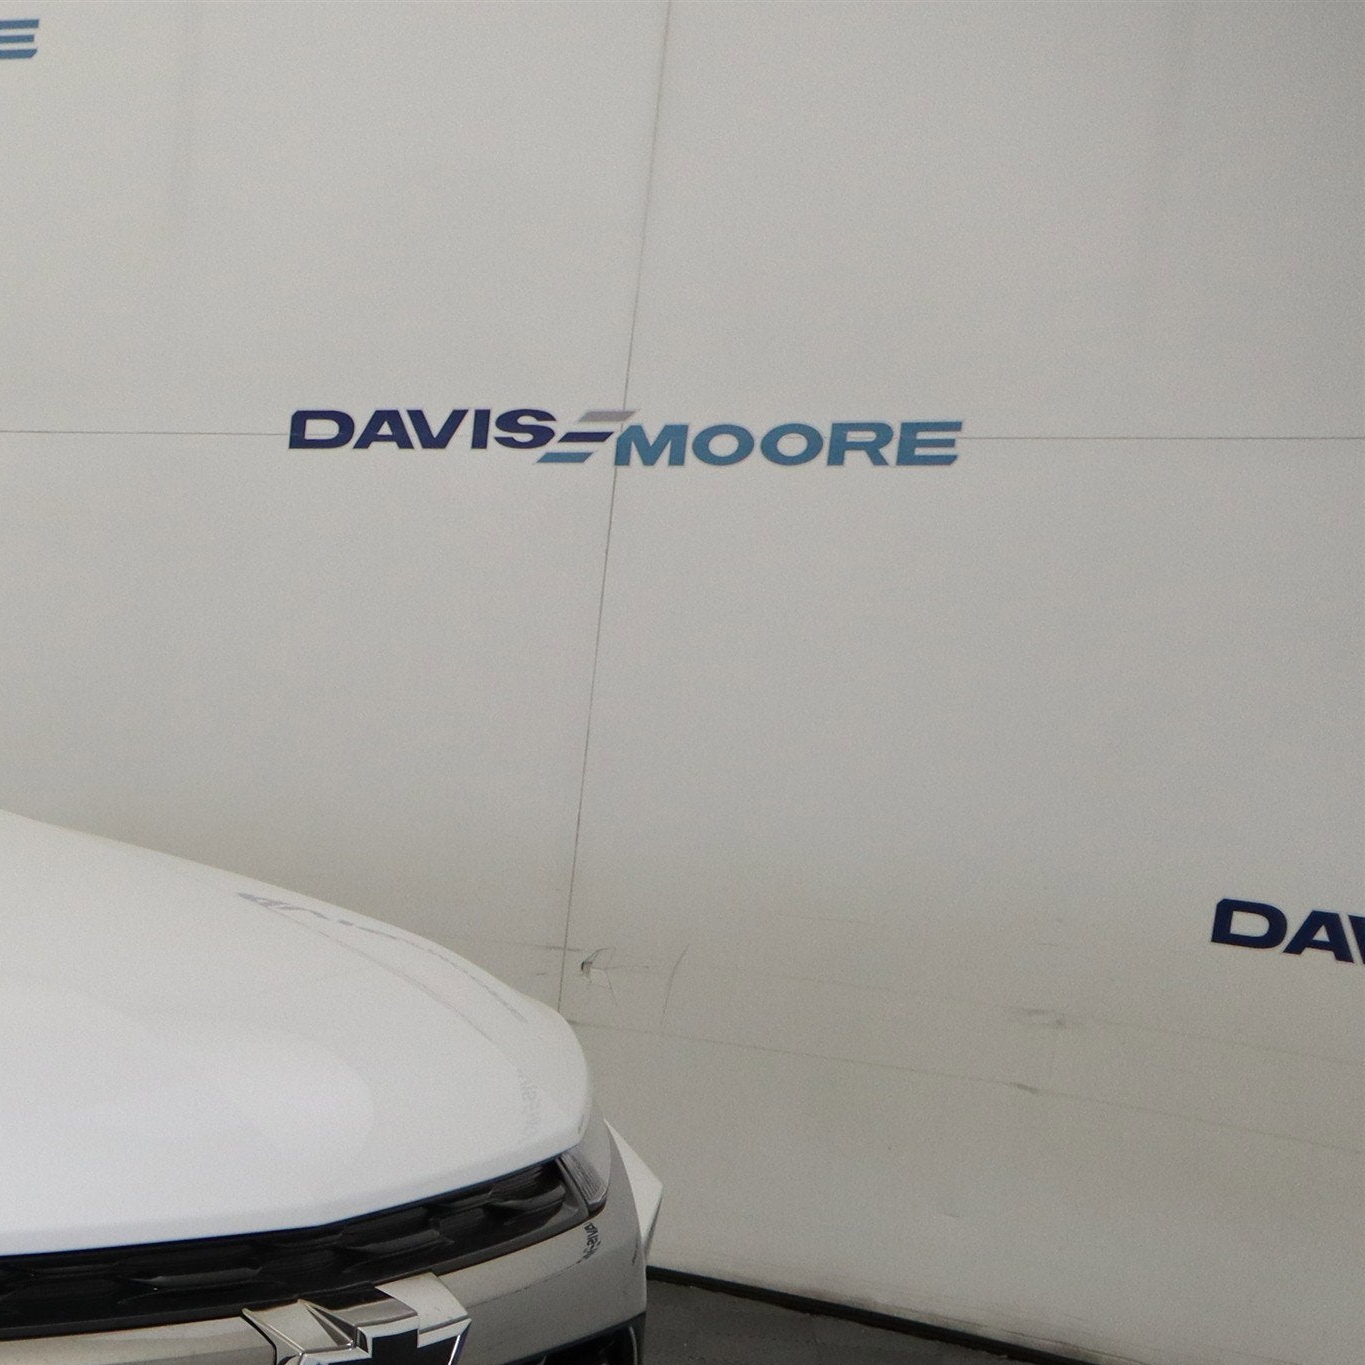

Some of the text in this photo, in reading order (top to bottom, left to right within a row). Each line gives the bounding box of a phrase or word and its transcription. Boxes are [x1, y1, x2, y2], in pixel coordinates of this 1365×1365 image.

[288, 409, 966, 467] DAVIS MOORE
[1211, 898, 1365, 965] DA
